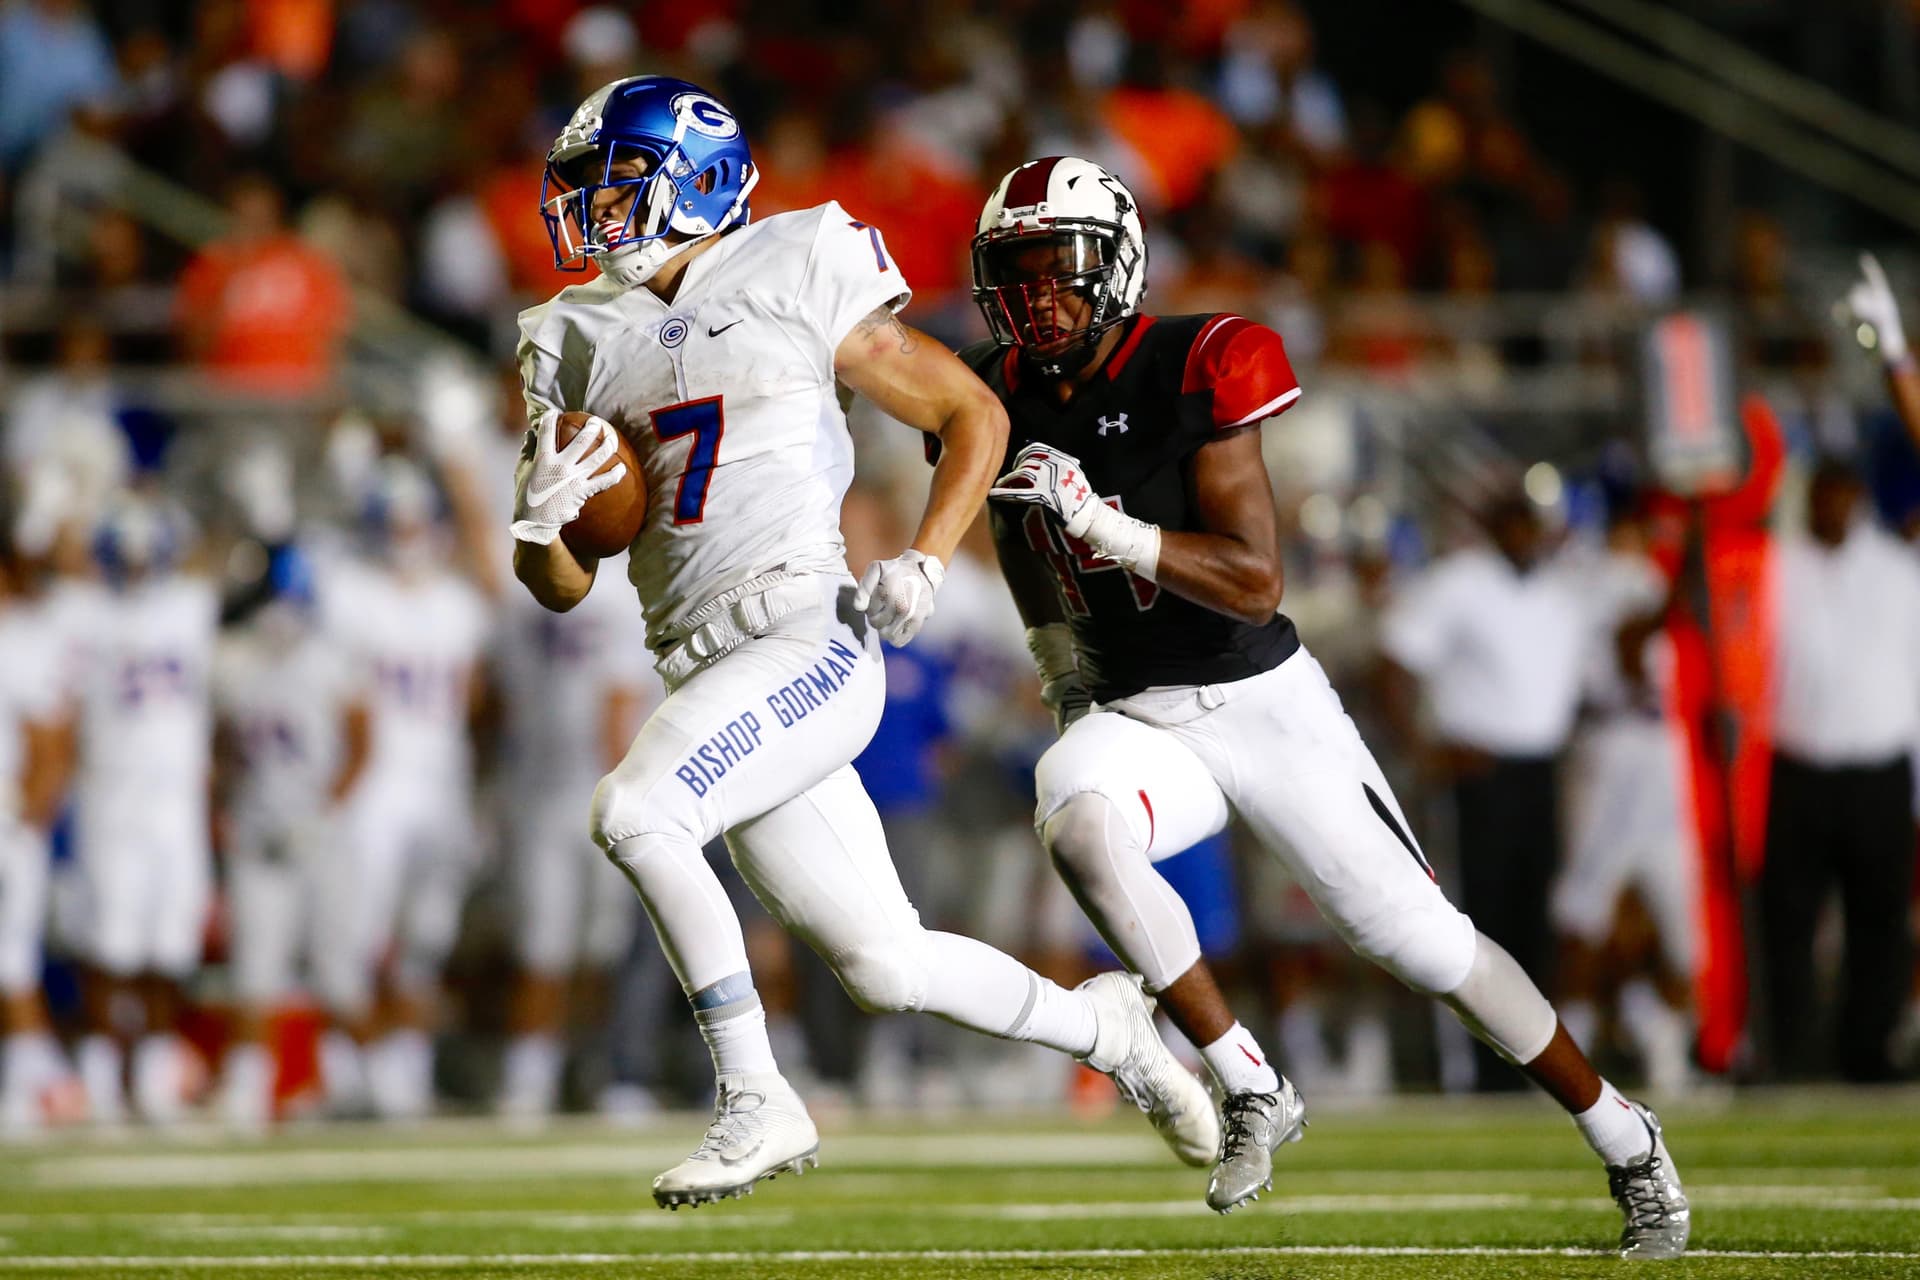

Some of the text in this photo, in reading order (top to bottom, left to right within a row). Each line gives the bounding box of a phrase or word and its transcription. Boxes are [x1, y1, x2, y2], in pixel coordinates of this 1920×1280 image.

[672, 93, 739, 139] G
[847, 221, 889, 272] 7
[648, 394, 724, 526] 7
[675, 638, 858, 799] BISHOP GORMAN
